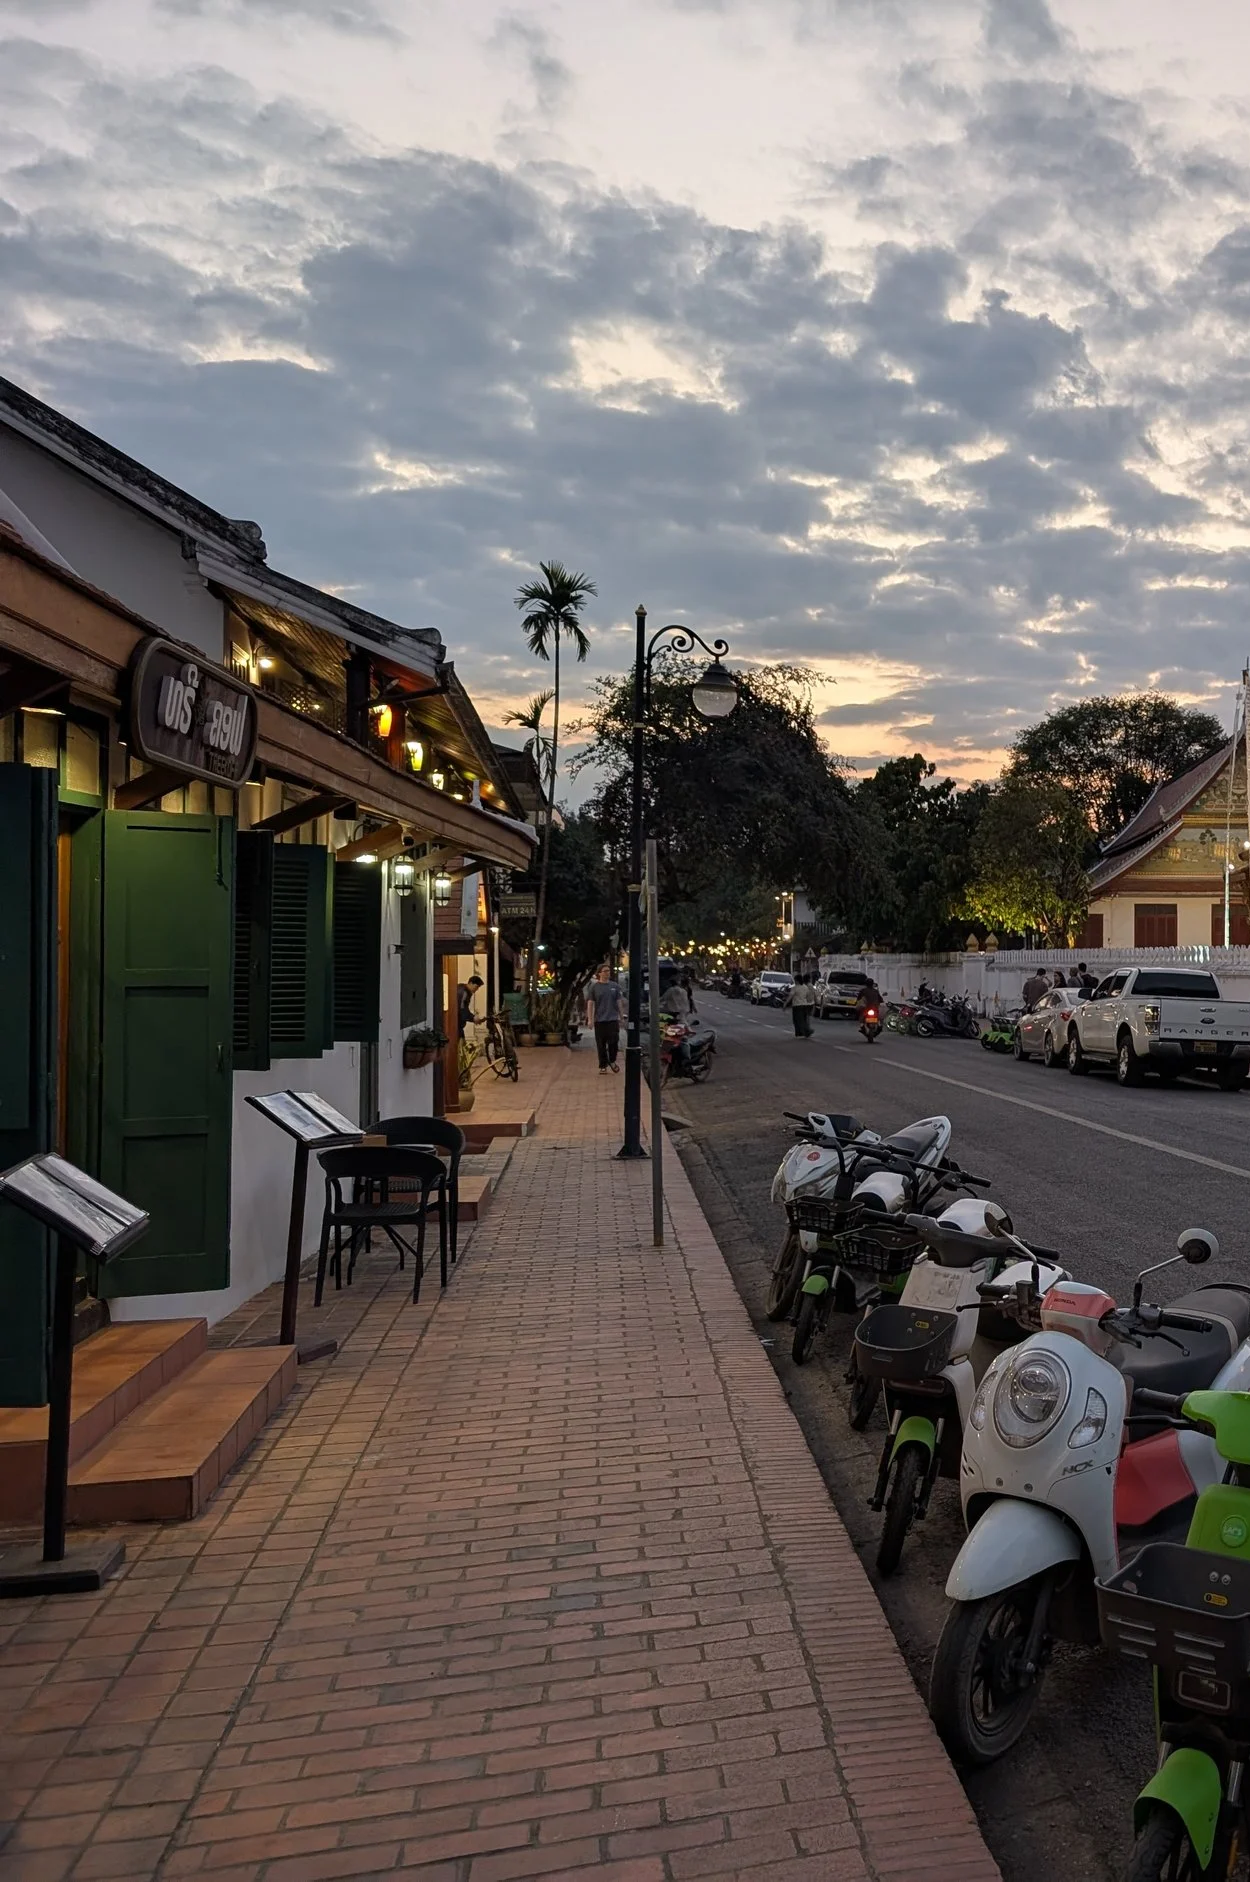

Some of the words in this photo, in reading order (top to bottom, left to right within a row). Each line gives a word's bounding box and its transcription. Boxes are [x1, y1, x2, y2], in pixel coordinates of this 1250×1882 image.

[501, 906, 519, 915] ATM
[1163, 1027, 1249, 1037] RANGER
[1053, 1298, 1077, 1307] HONDA
